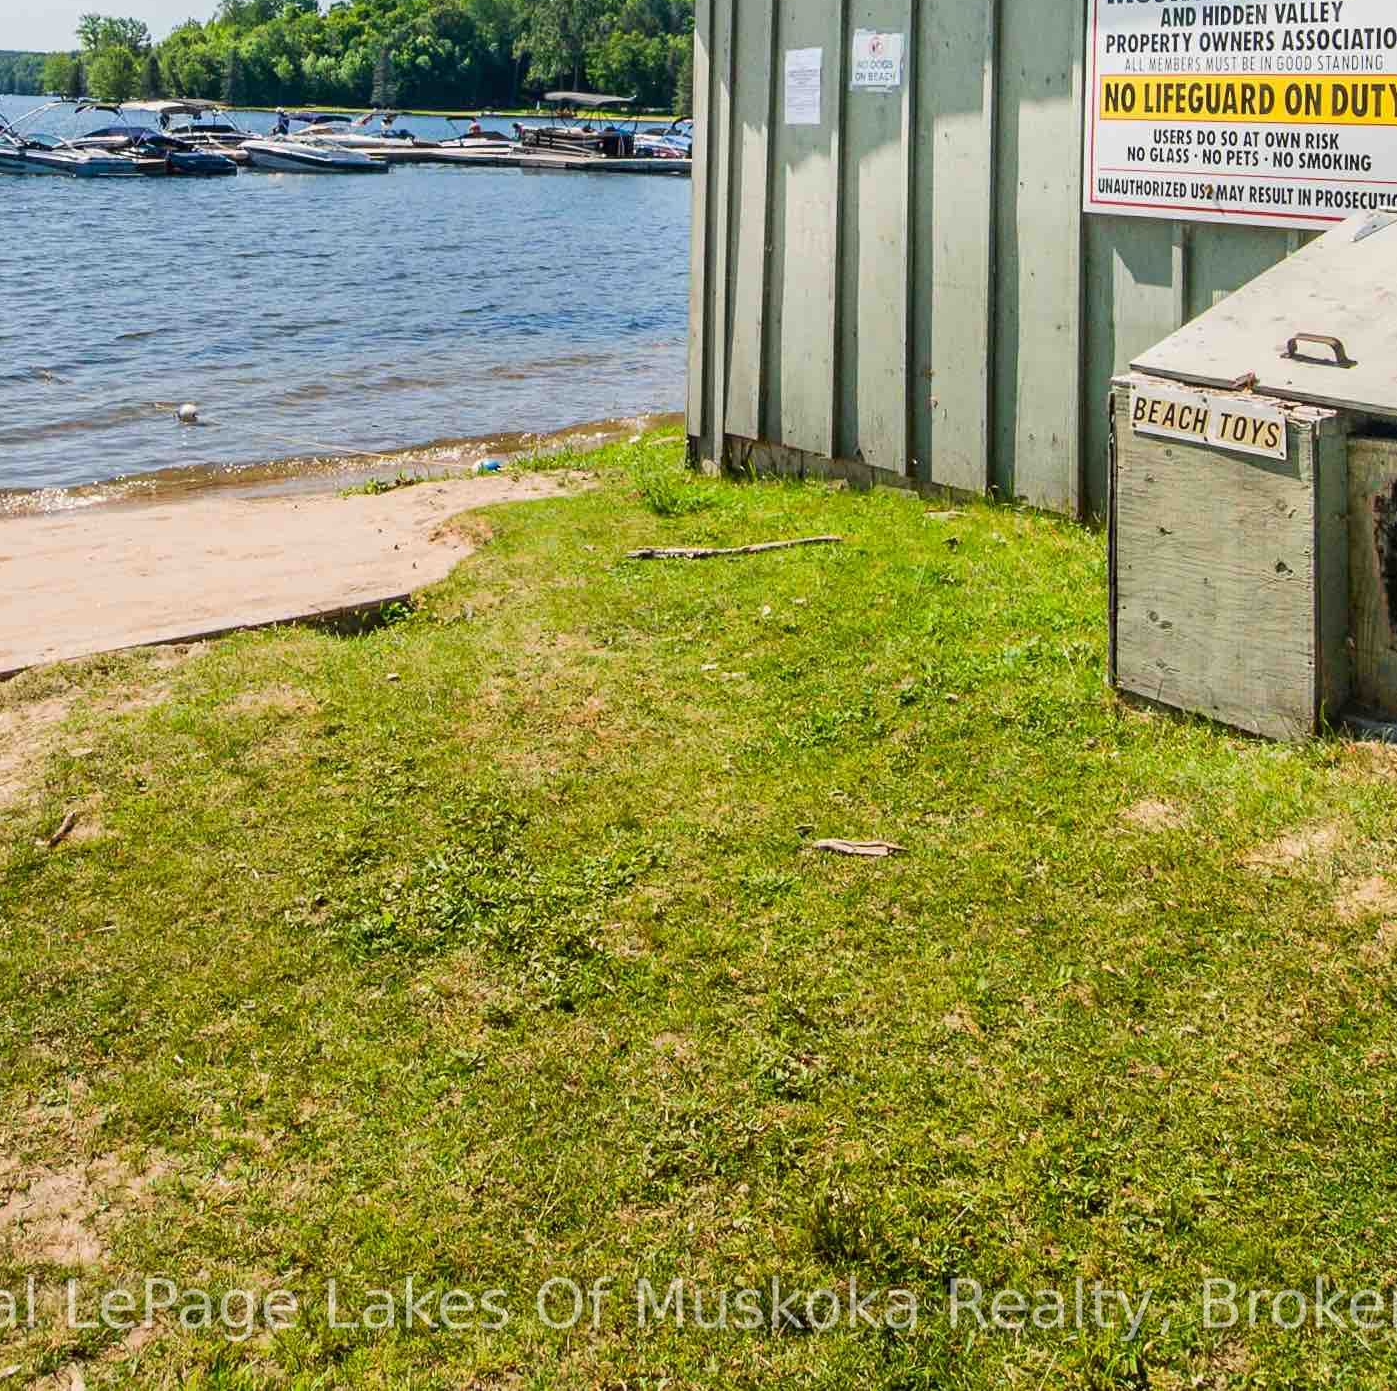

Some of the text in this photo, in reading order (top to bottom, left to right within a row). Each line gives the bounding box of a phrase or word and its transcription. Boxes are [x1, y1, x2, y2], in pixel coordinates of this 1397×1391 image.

[1160, 0, 1344, 28] AND HIDDEN VALLEY
[1105, 32, 1194, 54] PROPERTY
[1199, 30, 1275, 53] OWNERS
[1124, 57, 1145, 74] ALL
[1148, 56, 1201, 73] MEMBERS
[1203, 56, 1238, 72] MUST
[1242, 55, 1256, 72] BE
[1260, 55, 1272, 71] IN
[1276, 54, 1313, 71] GOOD
[1104, 82, 1136, 113] NO
[1143, 82, 1275, 116] LIFEGUARD
[1284, 82, 1322, 117] ON
[1153, 129, 1340, 150] USERS DO SO AT OWN RISK
[1127, 146, 1372, 171] NO GLASS NO PETS NO SMOKING
[1098, 177, 1187, 199] UNAUTHORIZED
[1216, 184, 1244, 202] MAY
[1249, 186, 1294, 206] RESULT
[1298, 189, 1312, 206] IN
[1133, 397, 1280, 448] BEACH TOYS
